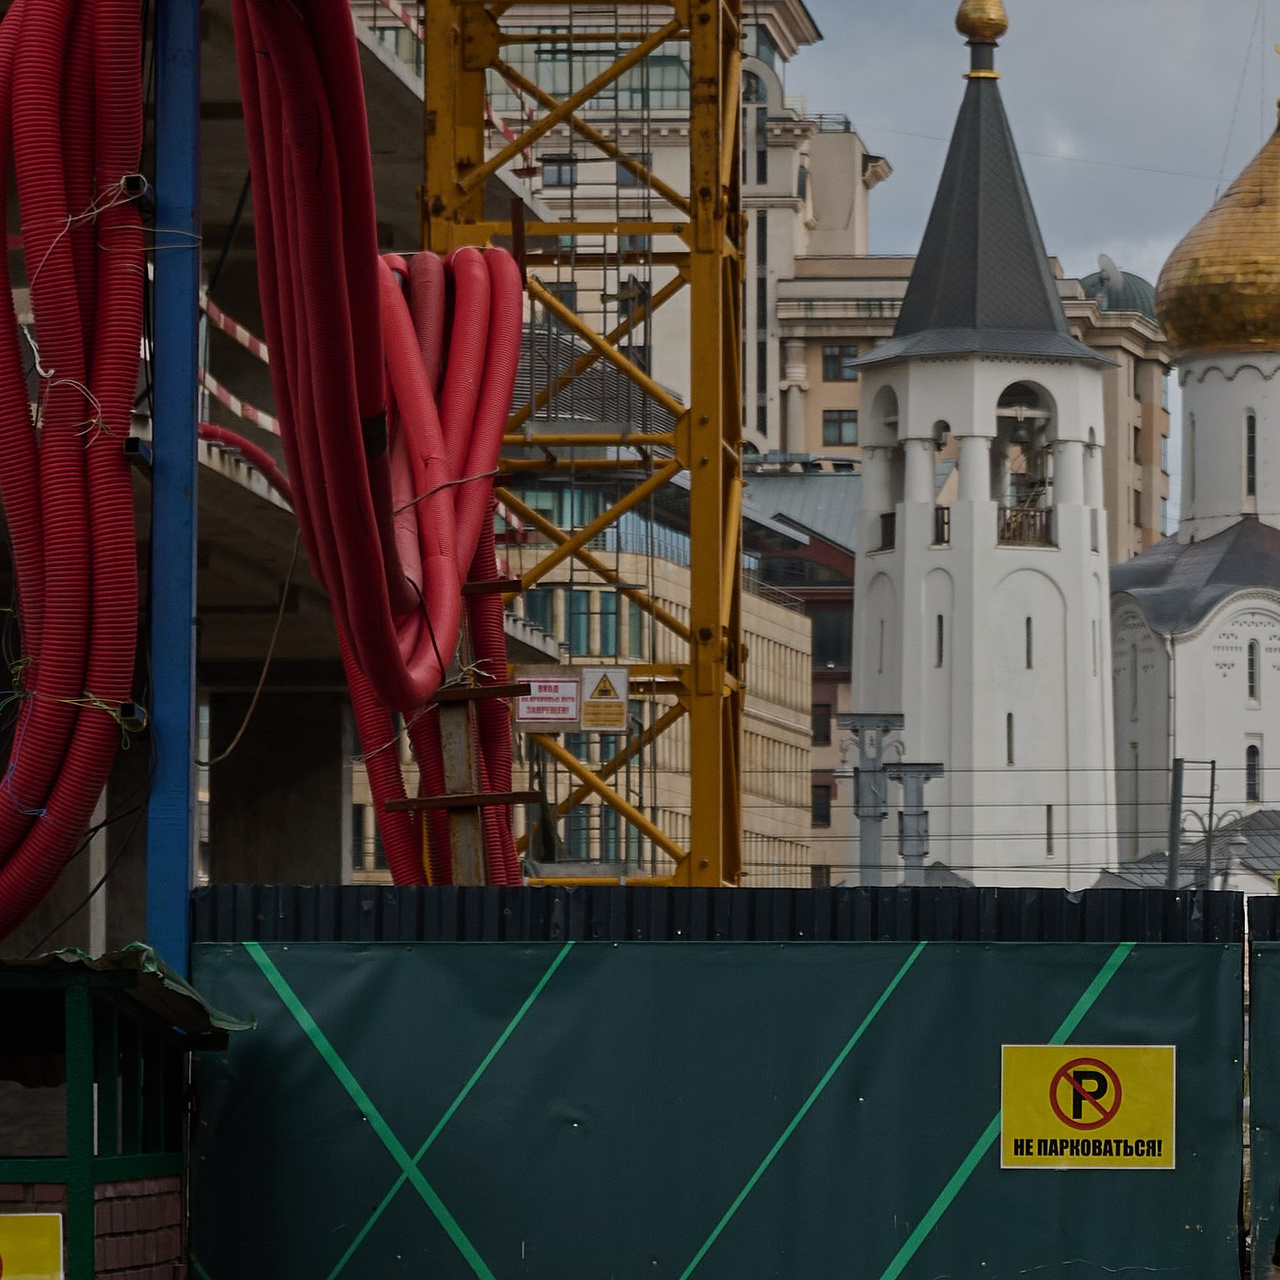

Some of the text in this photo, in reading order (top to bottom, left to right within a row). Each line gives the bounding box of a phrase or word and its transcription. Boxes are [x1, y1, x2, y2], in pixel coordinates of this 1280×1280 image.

[538, 685, 559, 693] ВХОД
[1013, 1138, 1163, 1157] НЕ ПАРКОВАТЬСЯ!
